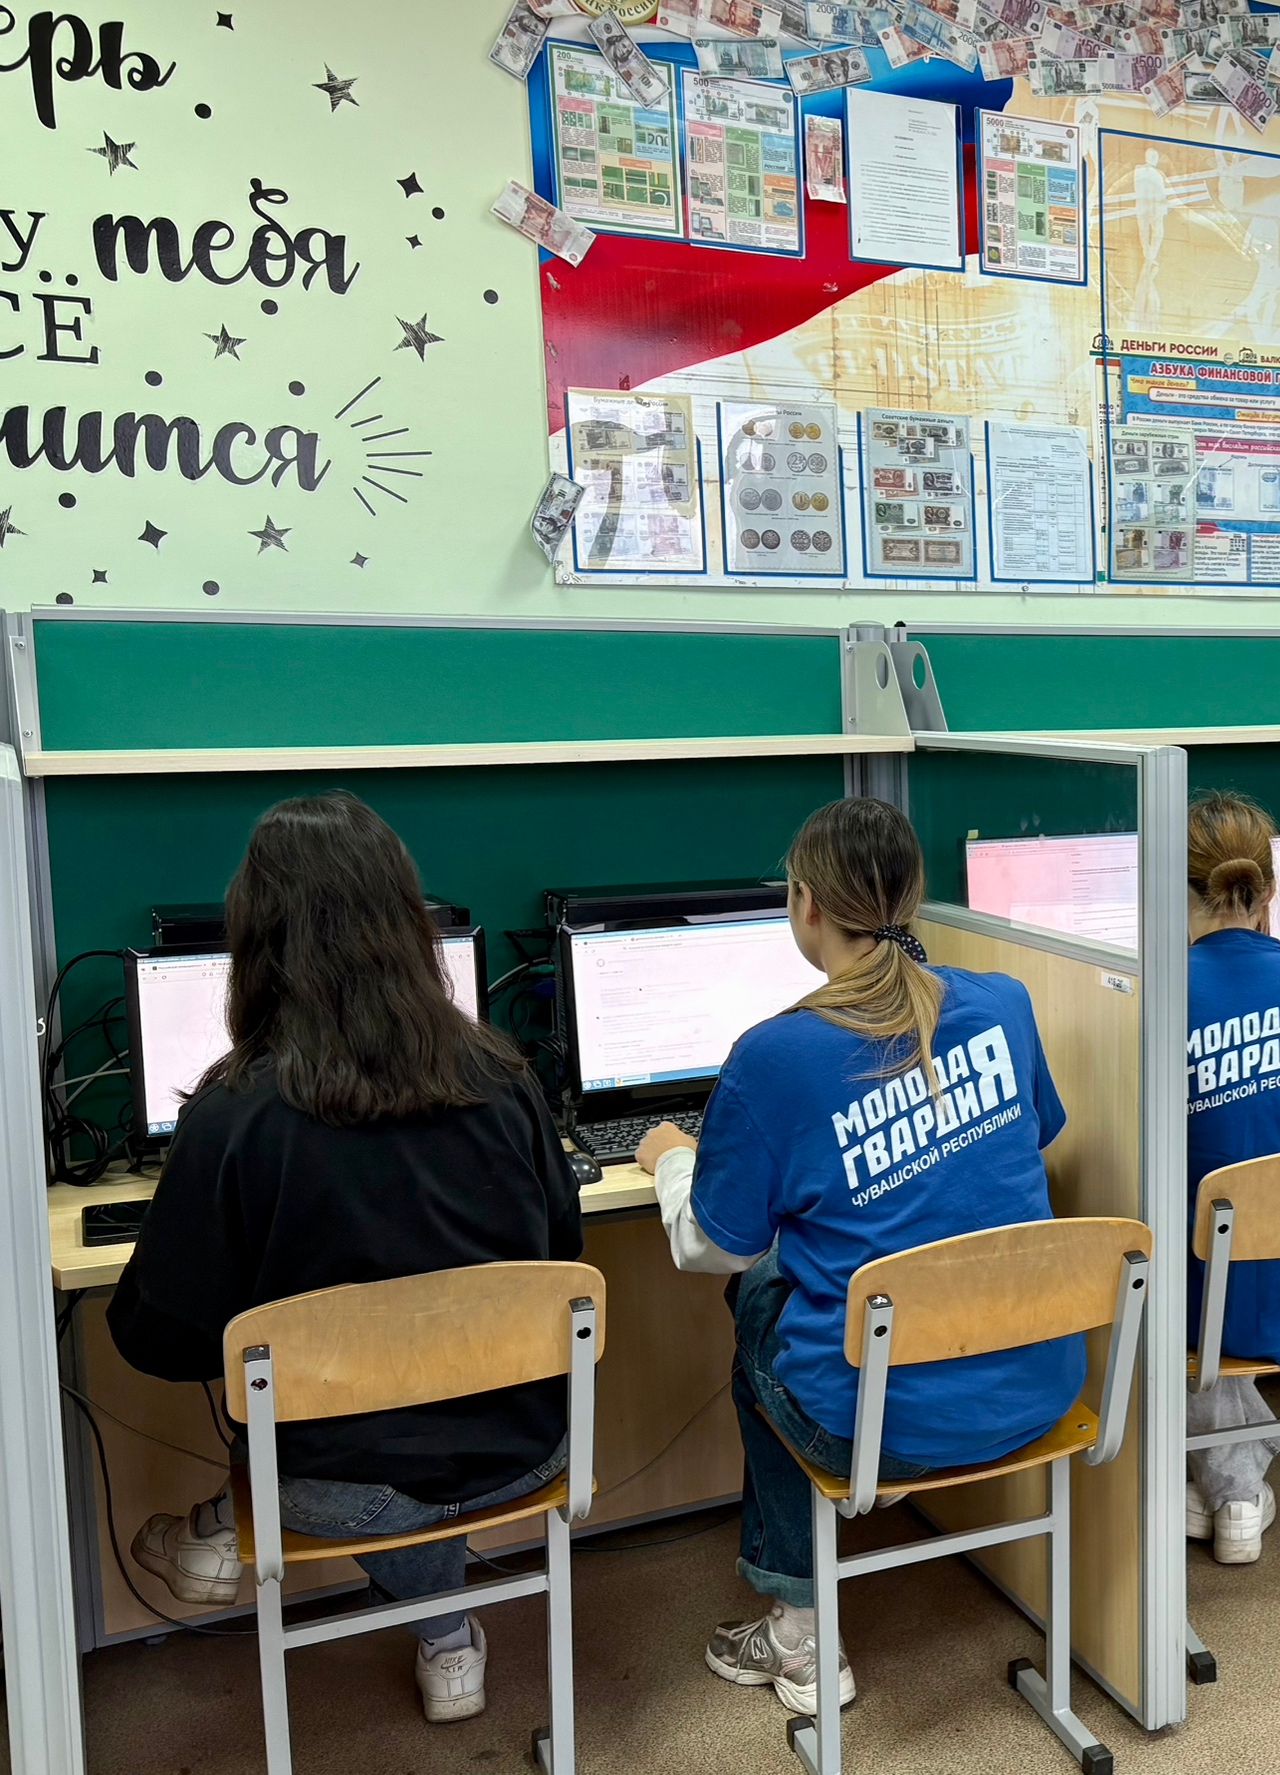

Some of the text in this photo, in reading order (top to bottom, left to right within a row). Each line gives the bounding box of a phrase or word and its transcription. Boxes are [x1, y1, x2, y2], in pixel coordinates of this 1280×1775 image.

[816, 3, 837, 15] 2000
[556, 51, 572, 59] 200
[1139, 55, 1162, 69] 500
[693, 77, 709, 87] 500
[986, 117, 1005, 127] 5000
[92, 178, 360, 295] тебя
[1121, 339, 1218, 356] ДЕНЬГИ РОССИИ
[1150, 362, 1194, 376] АЗБУКА
[1197, 367, 1271, 383] ФИНАНСОВОЙ
[1187, 1080, 1257, 1115] УВАШСКОЙ
[851, 1103, 1022, 1208] ЧУВАШСКОЙ РЕСПУБЛИКИ
